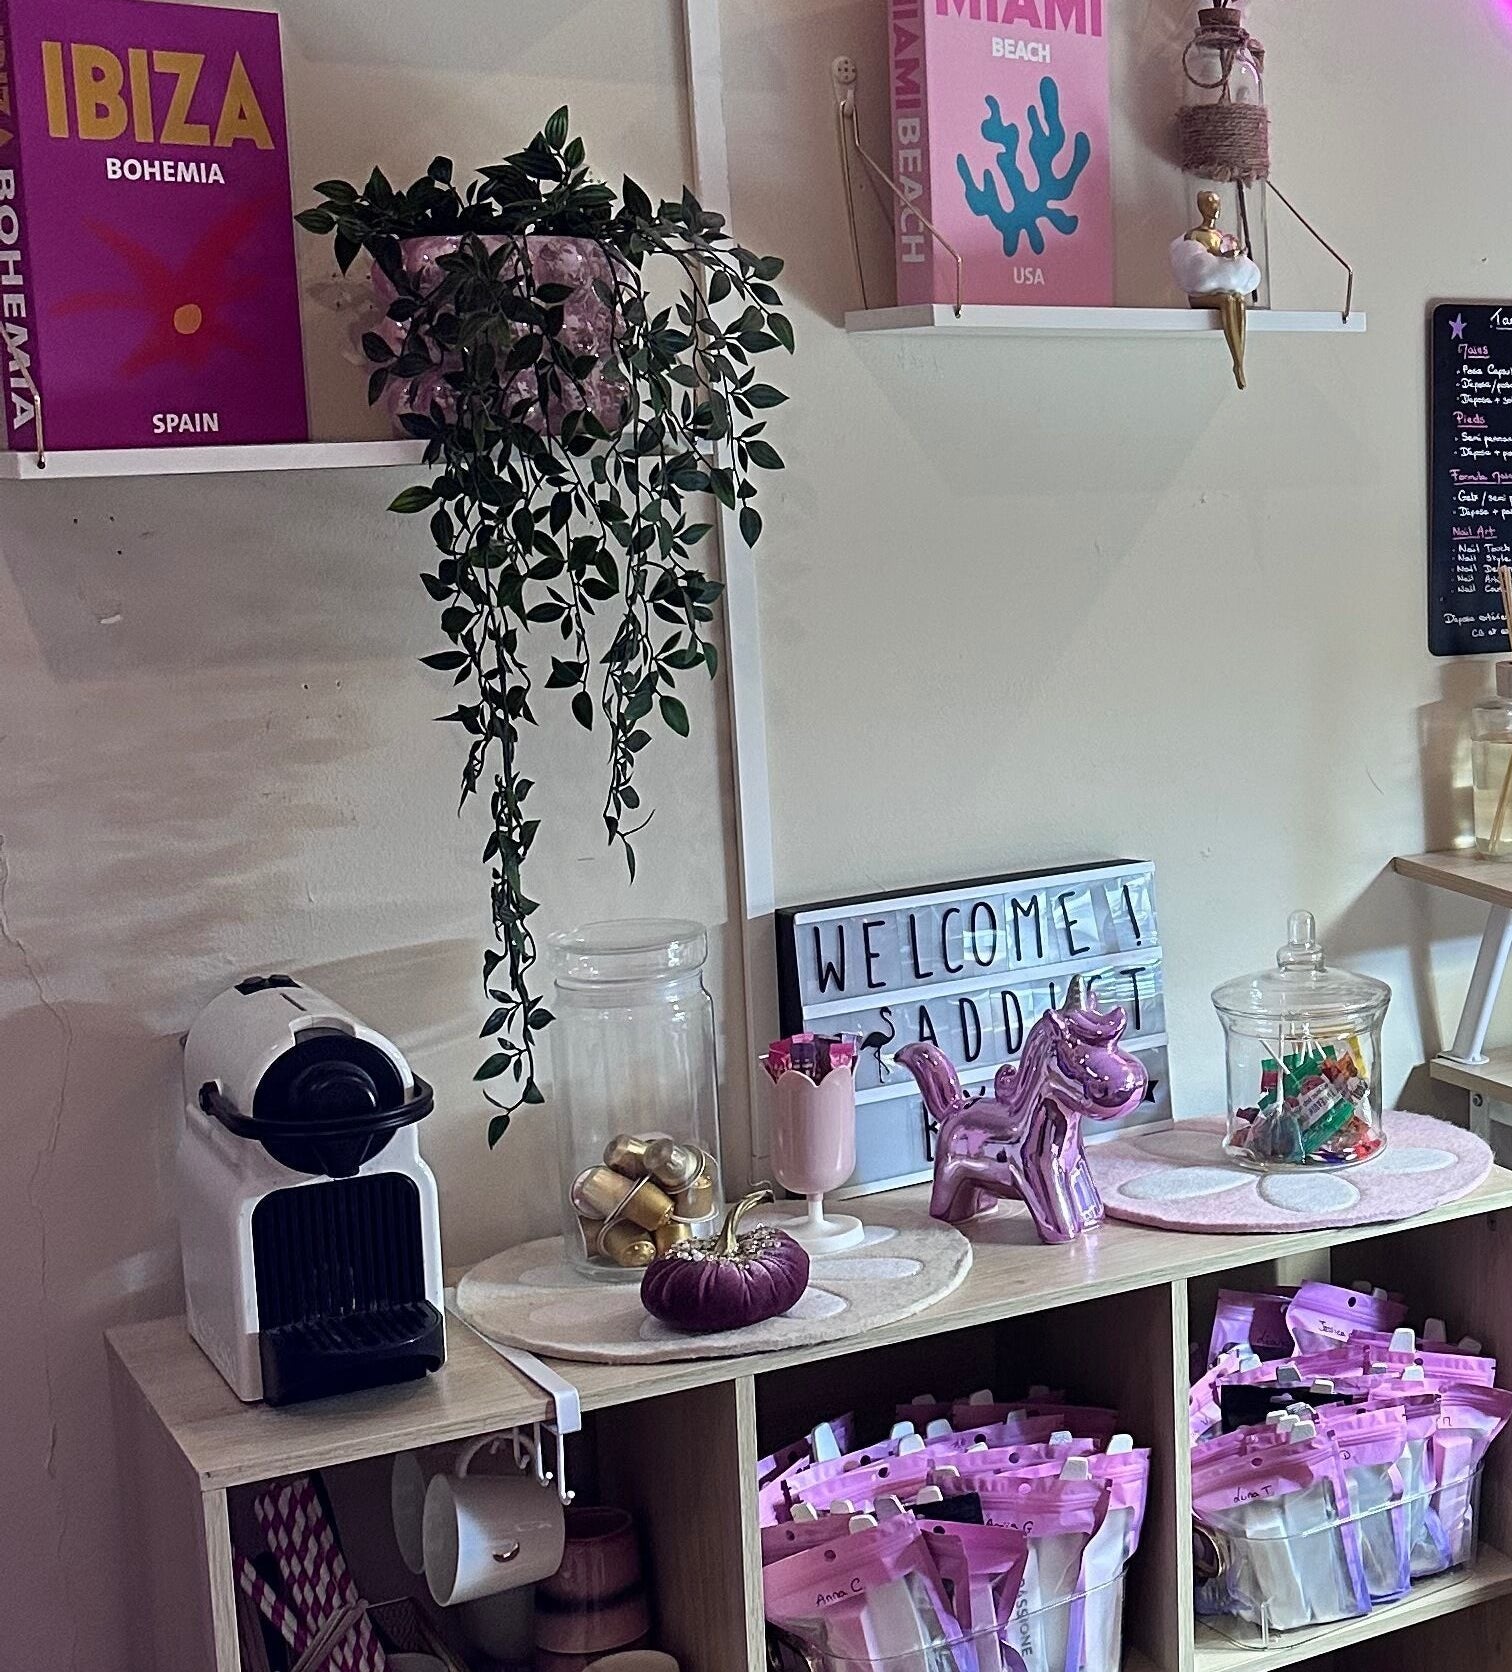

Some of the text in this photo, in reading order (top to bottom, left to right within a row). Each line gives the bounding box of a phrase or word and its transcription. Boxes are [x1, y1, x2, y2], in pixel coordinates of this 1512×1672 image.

[935, 0, 1102, 37] AMI
[892, 0, 922, 110] IAMI
[991, 37, 1052, 64] BEACH
[41, 40, 275, 151] IBIZA
[105, 156, 226, 186] BOHEMIA
[897, 117, 926, 264] BEACH
[1012, 266, 1046, 287] USA
[0, 169, 37, 430] BOHEMIA
[152, 412, 220, 435] SPAIN
[1453, 411, 1486, 424] Pieds
[1461, 432, 1482, 442] Semi
[1452, 525, 1496, 538] Nail Art
[1458, 554, 1477, 562] Nail
[1459, 544, 1480, 552] Nail
[1457, 564, 1478, 572] Nail
[1458, 584, 1477, 593] Nail
[813, 884, 1143, 993] WELCOME !
[816, 1577, 863, 1607] Anna C
